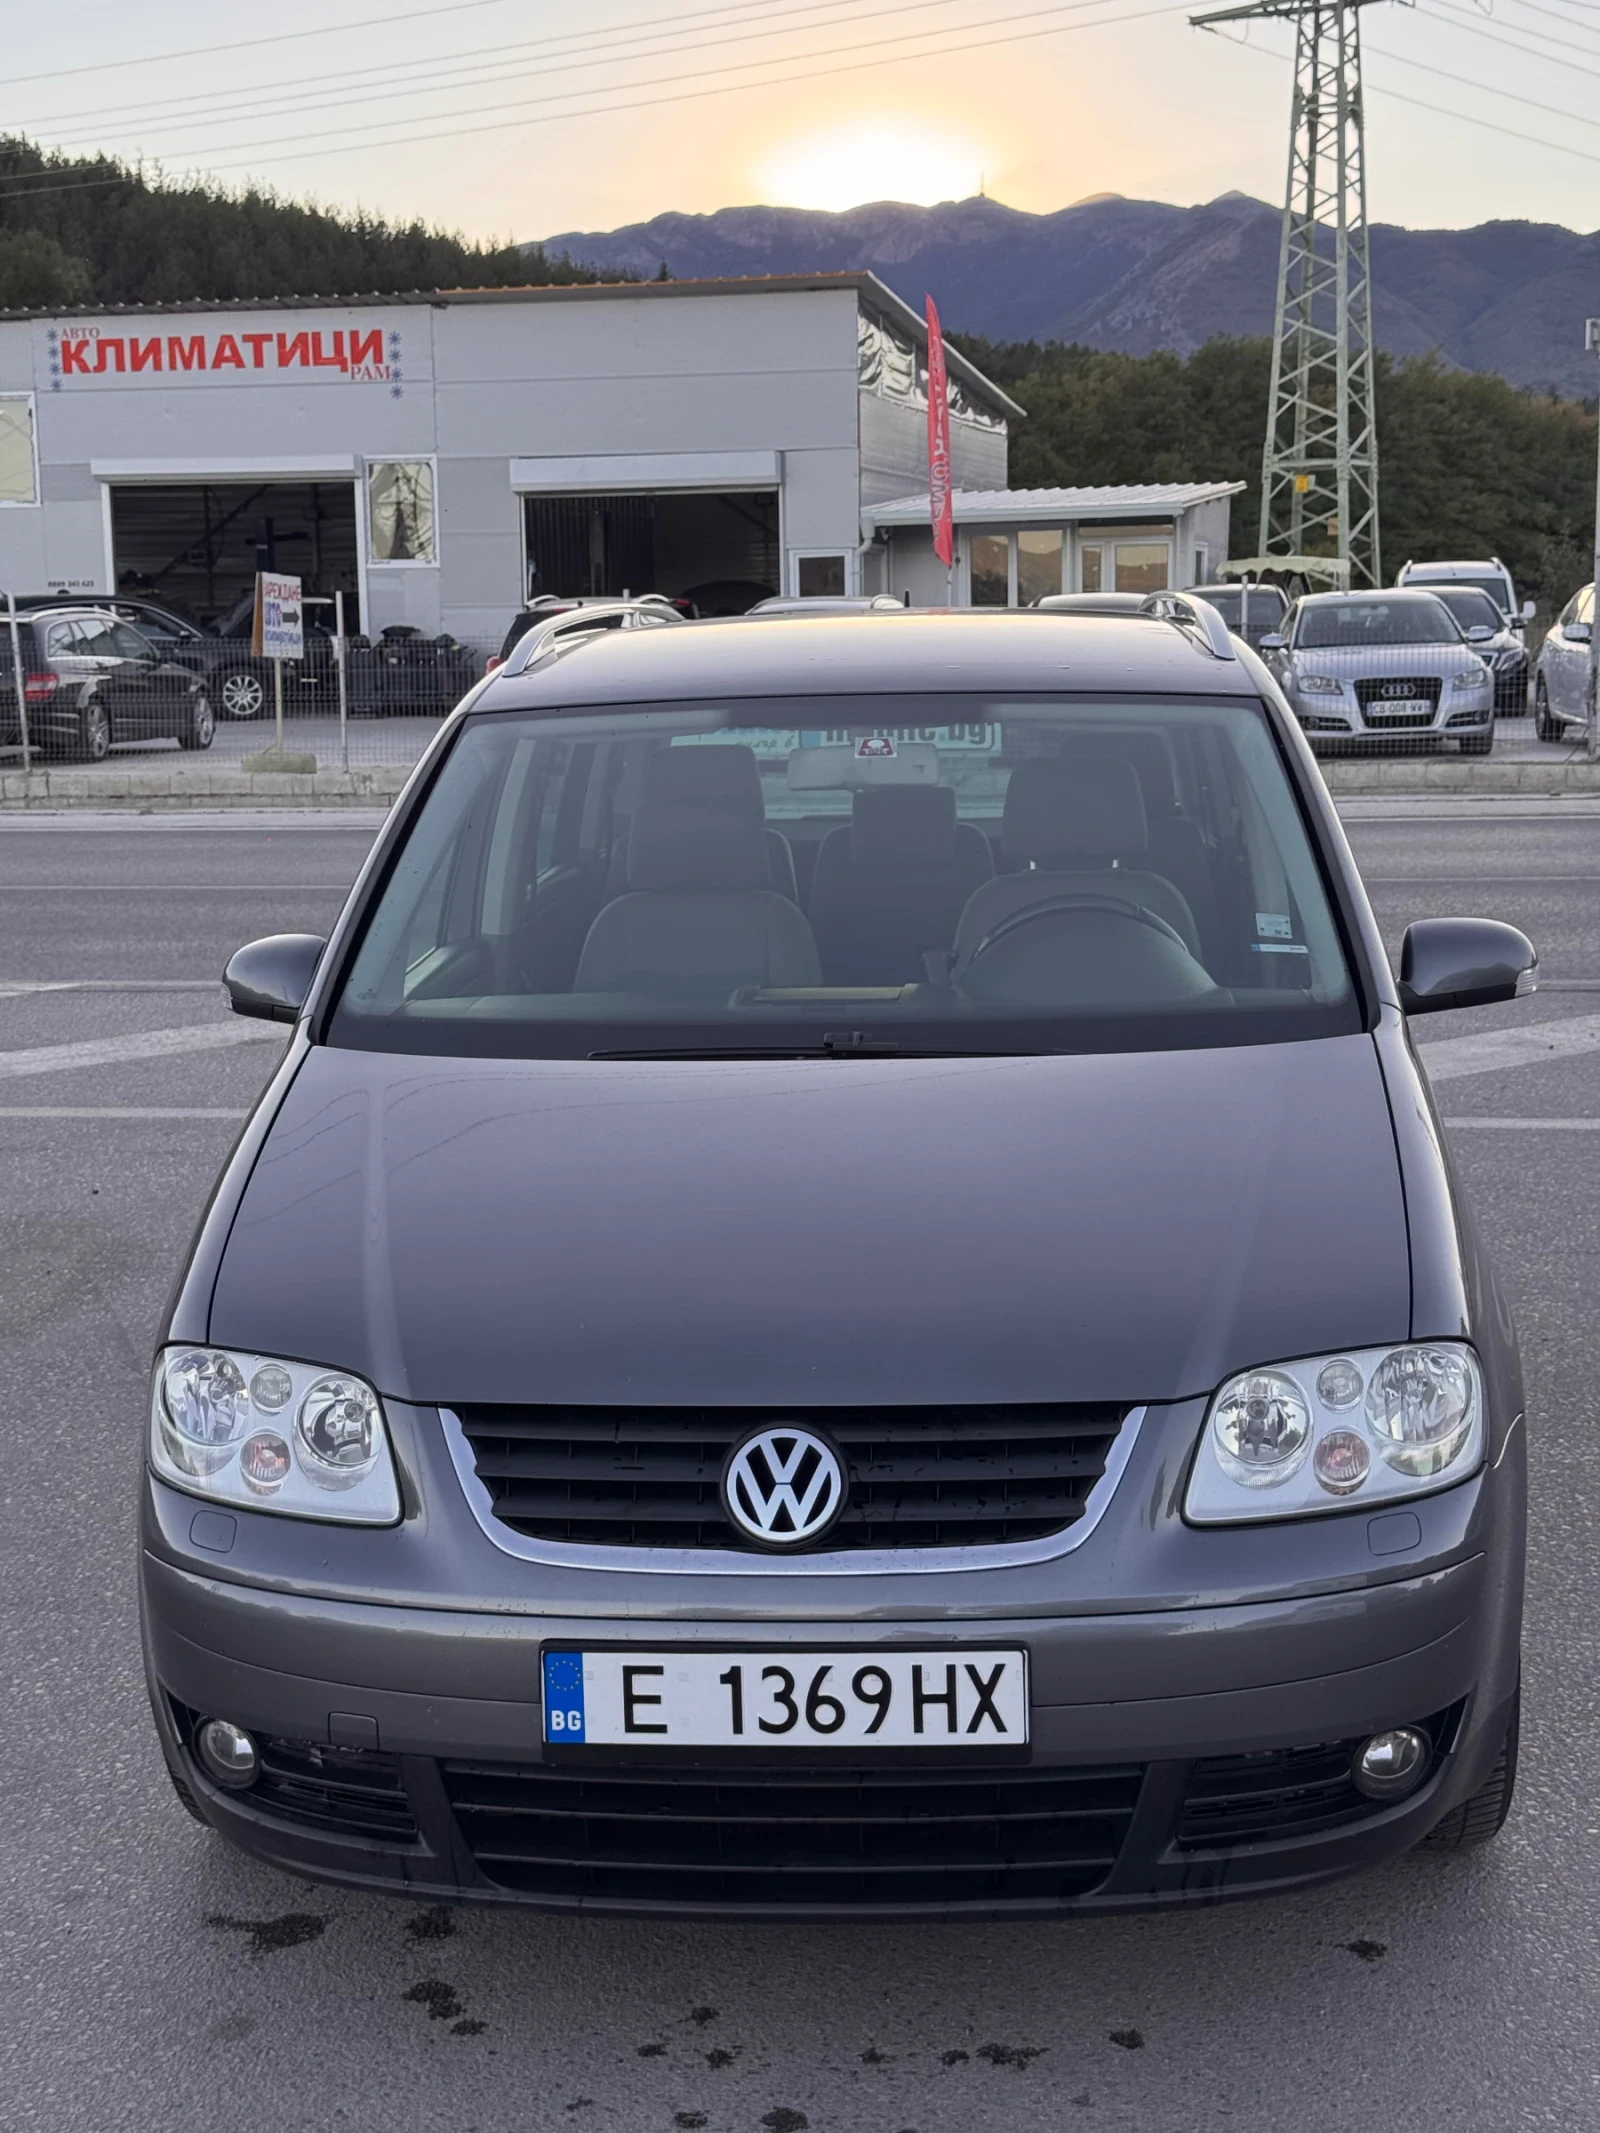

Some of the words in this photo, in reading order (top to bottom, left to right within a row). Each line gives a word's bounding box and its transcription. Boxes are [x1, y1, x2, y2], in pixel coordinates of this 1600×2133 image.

[61, 327, 100, 339] АВТО
[61, 329, 383, 374] КЛИМАТИЦИ
[351, 366, 391, 380] РАМ
[729, 1431, 839, 1539] VW
[622, 1664, 668, 1734] E
[551, 1710, 582, 1731] BG
